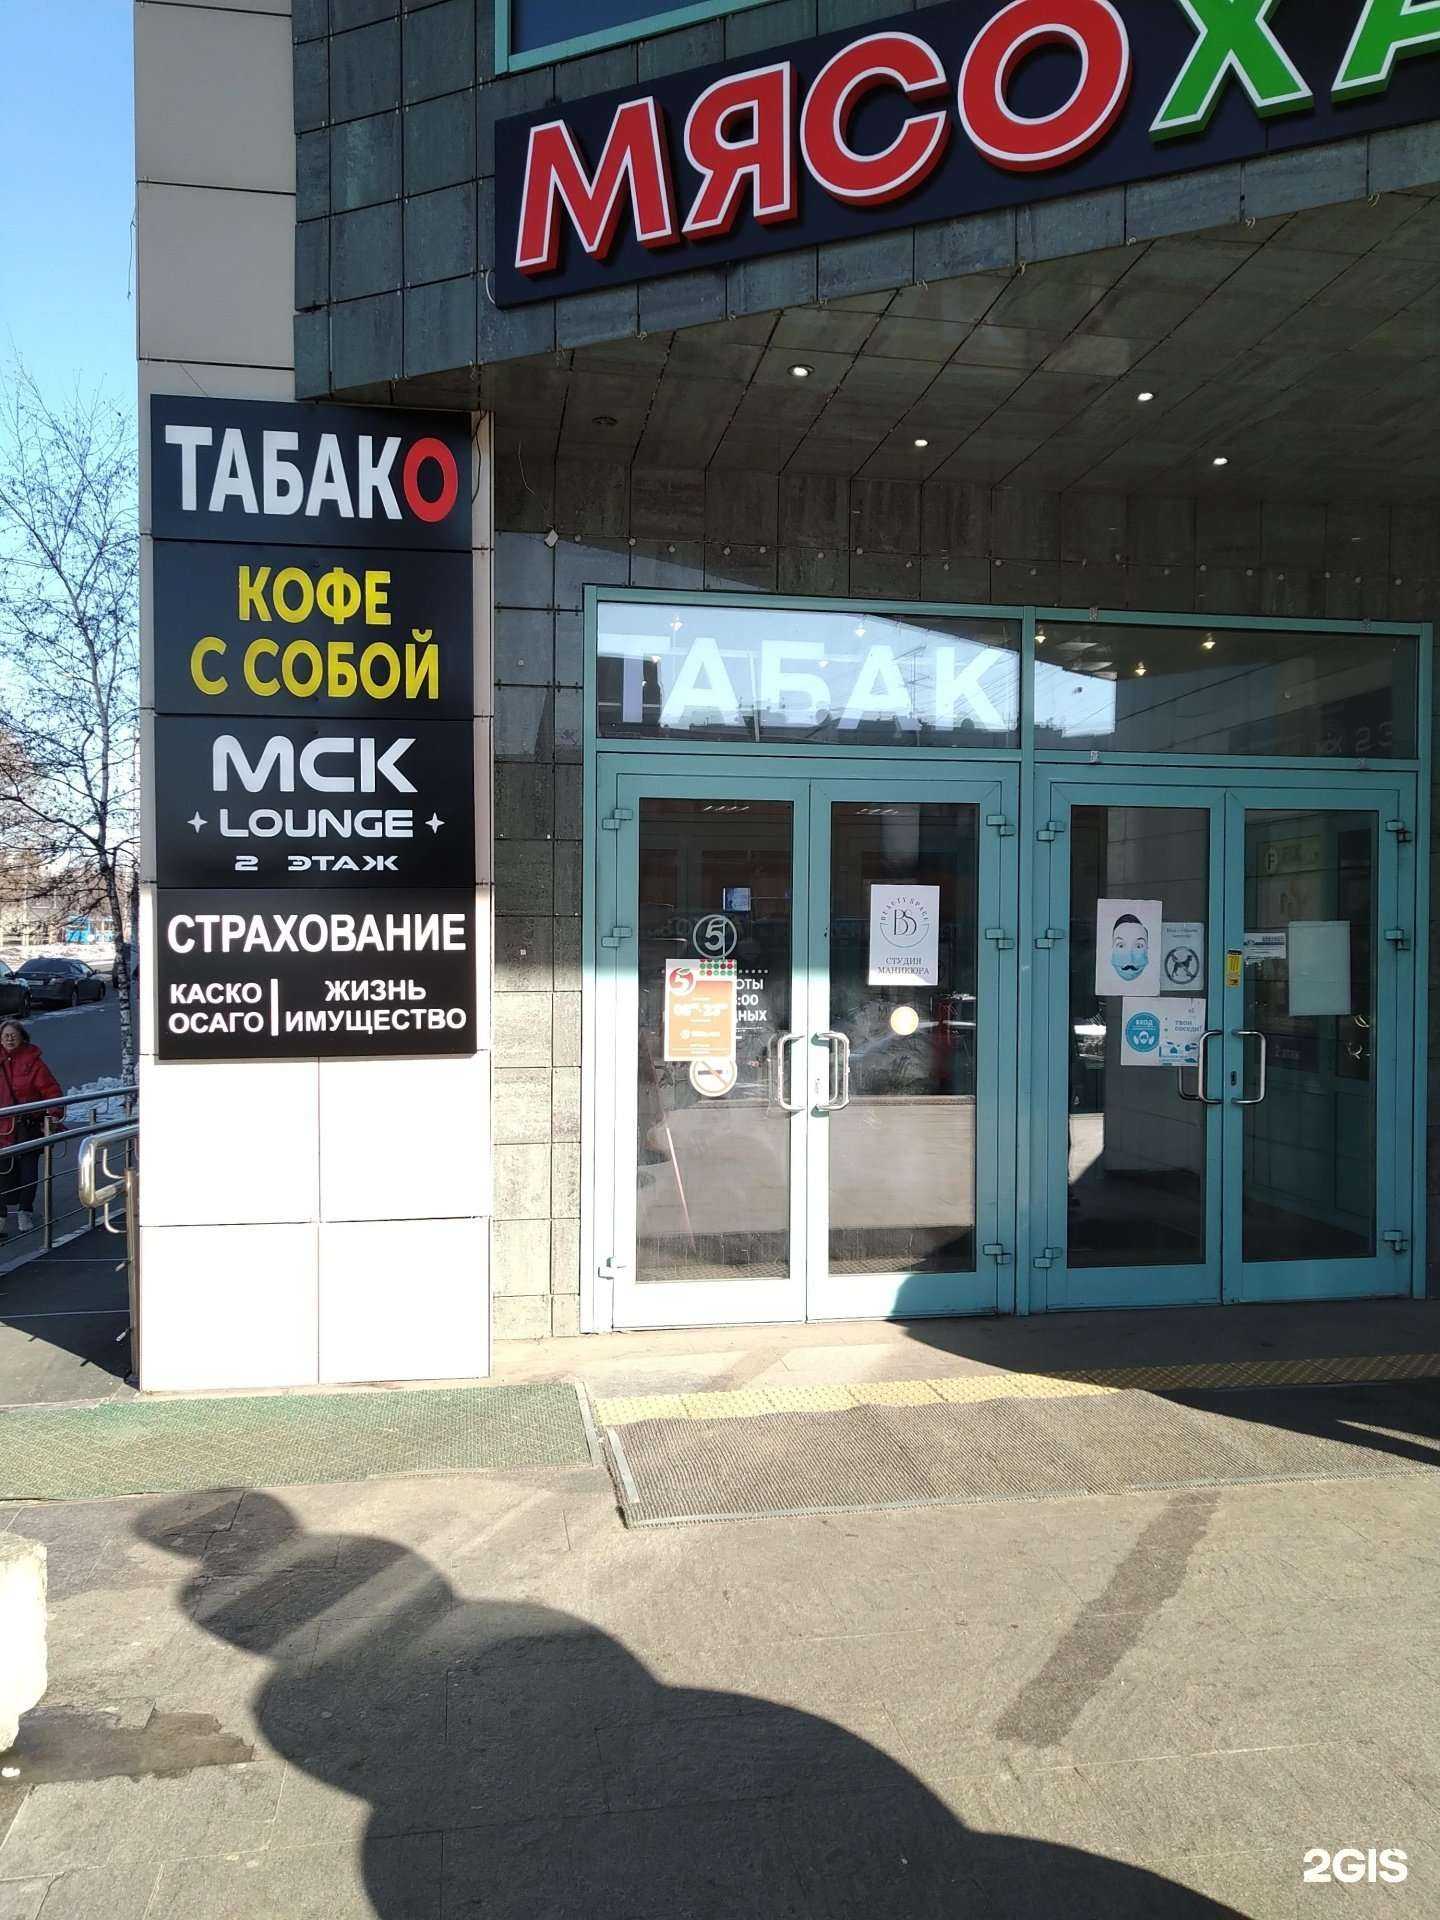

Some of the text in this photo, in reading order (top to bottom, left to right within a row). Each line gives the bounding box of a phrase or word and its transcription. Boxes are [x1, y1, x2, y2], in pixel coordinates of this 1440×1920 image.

[164, 424, 458, 522] ТАБАКО
[238, 566, 392, 625] КОФЕ
[190, 629, 439, 700] С СОБОЙ
[597, 633, 1008, 732] ТАБАК
[212, 734, 418, 793] МСК
[219, 808, 414, 838] LOUNGE
[234, 855, 400, 871] 2 ЭТАЖ
[167, 913, 467, 953] СТРАХОВАНИЕ
[170, 982, 263, 1005] КАСКО
[324, 979, 427, 1002] ЖИЗНЬ
[168, 1011, 264, 1034] ОСАГО
[285, 1008, 467, 1035] ИМУЩЕСТВО
